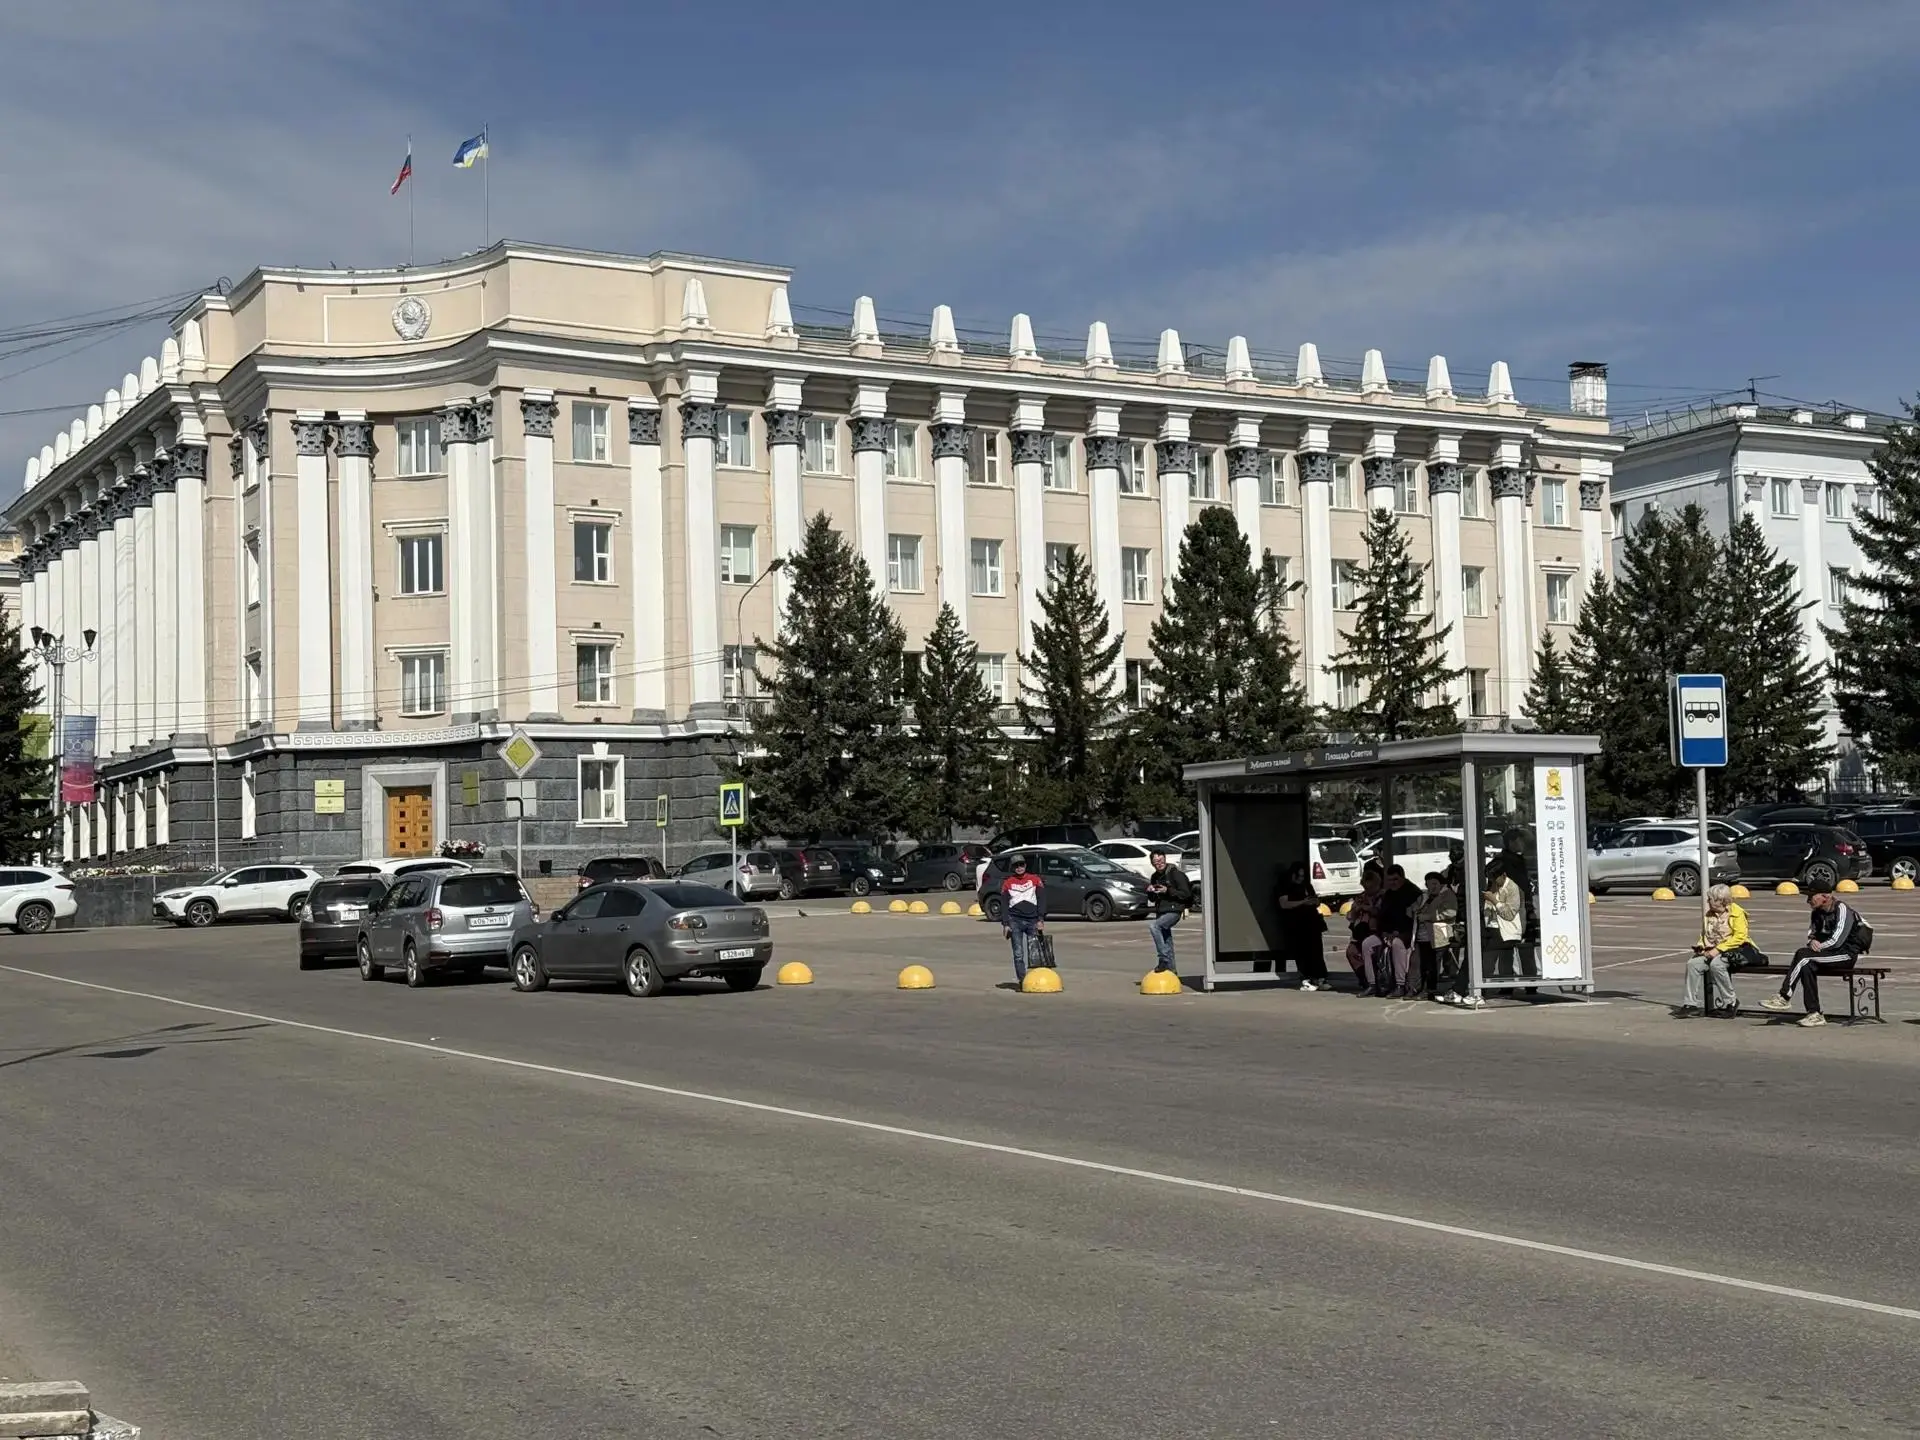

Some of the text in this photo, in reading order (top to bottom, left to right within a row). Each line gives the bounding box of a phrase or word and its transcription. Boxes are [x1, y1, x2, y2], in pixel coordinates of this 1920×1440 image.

[1325, 750, 1373, 760] Площадь Советов
[1557, 837, 1565, 869] талмай
